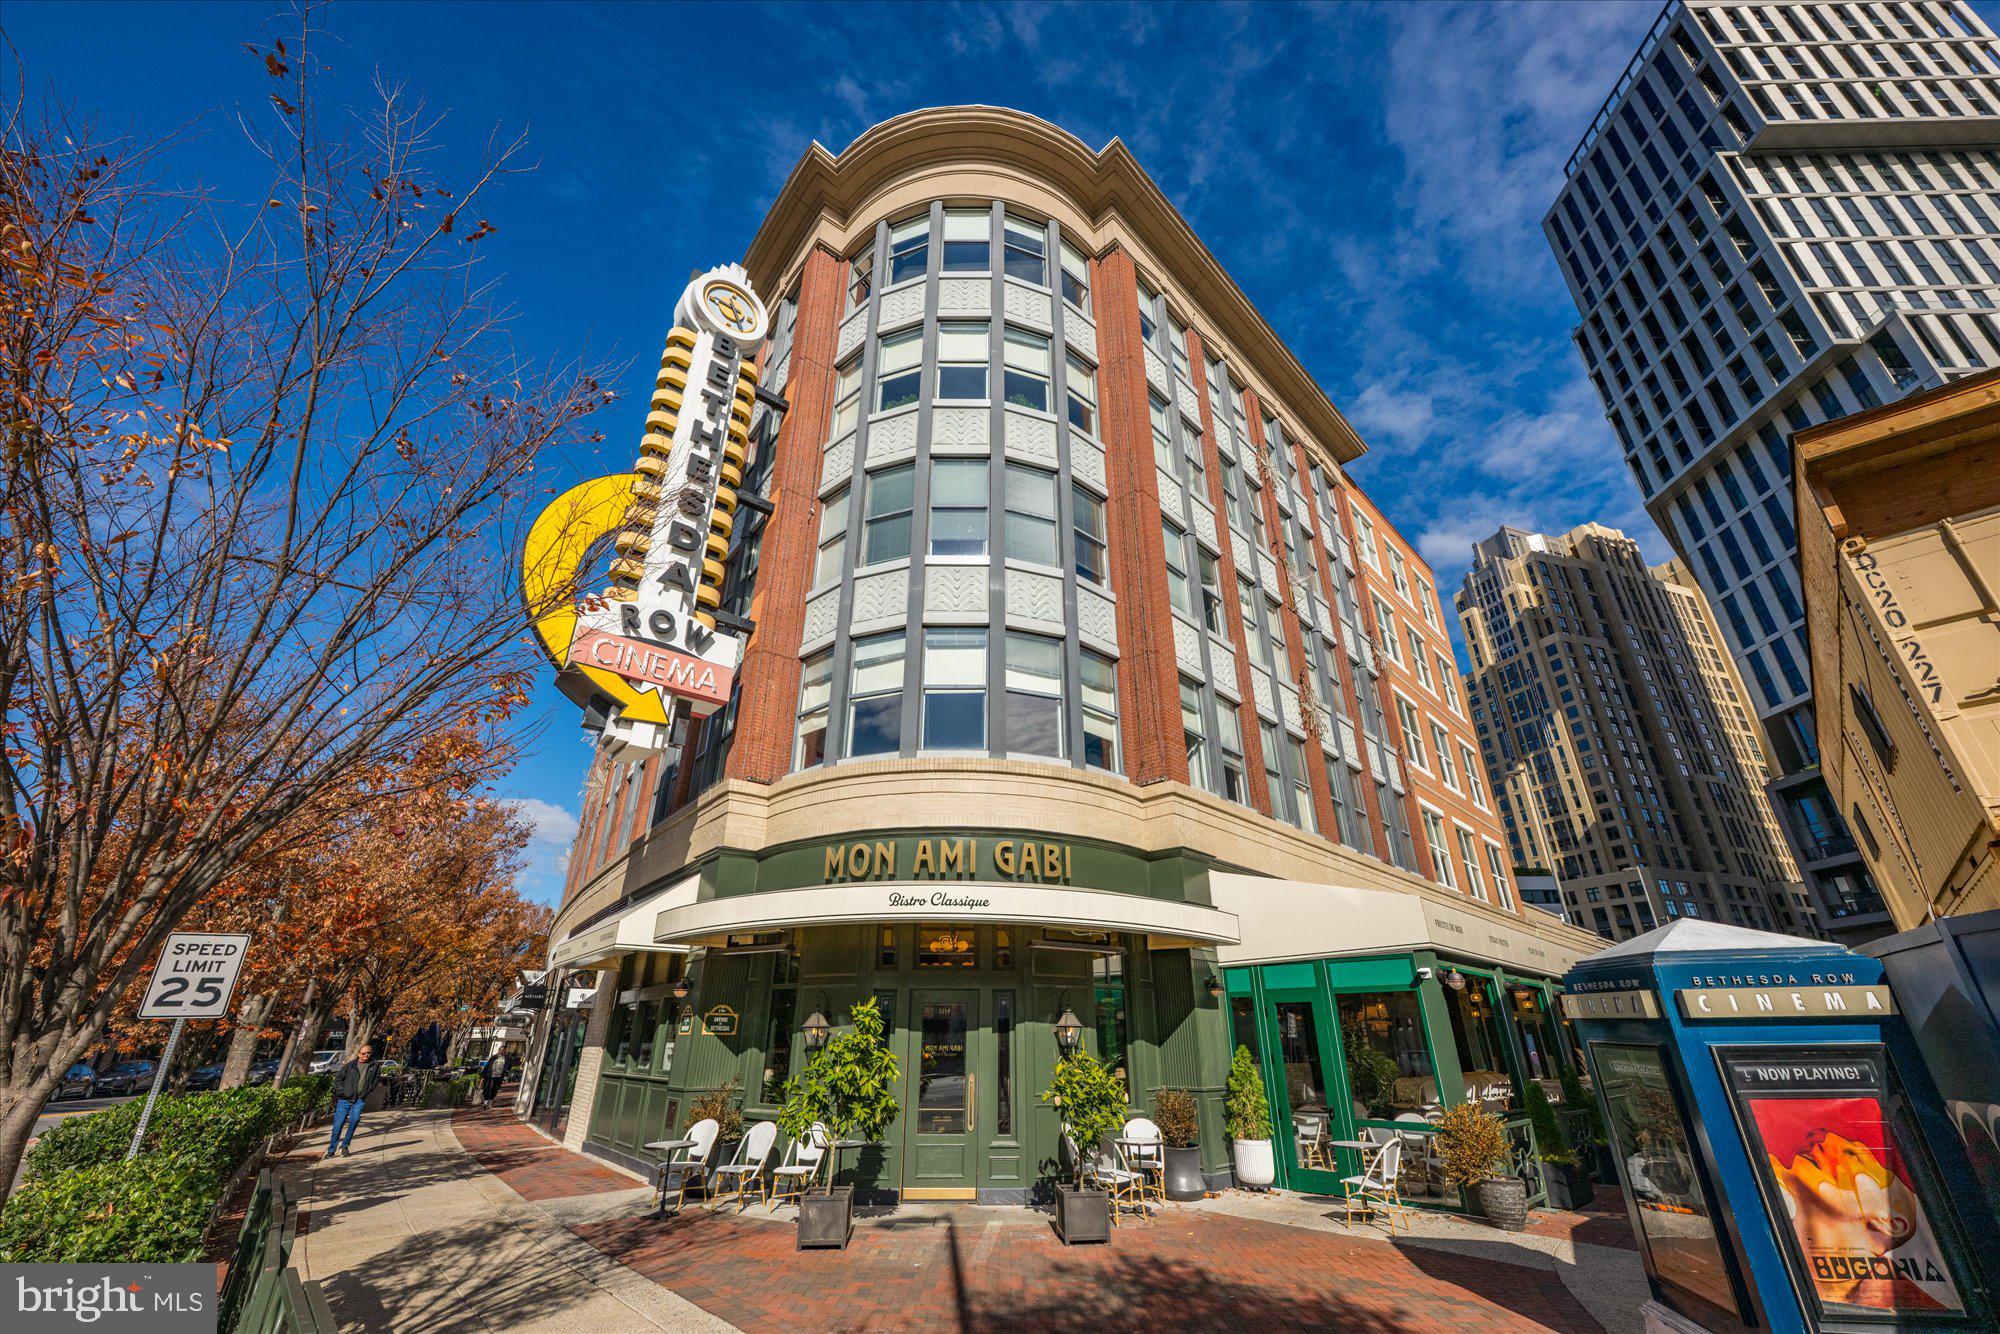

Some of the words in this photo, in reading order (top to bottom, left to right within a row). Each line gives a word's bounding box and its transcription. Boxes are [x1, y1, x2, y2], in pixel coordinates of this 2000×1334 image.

[656, 330, 736, 594] BETHESDA
[620, 604, 714, 653] ROW
[591, 638, 717, 694] CINEMA
[1901, 641, 1942, 703] 227
[824, 841, 896, 880] MON
[912, 840, 976, 878] AMI
[993, 840, 1071, 882] GABI
[888, 892, 927, 907] Bistro
[930, 892, 990, 910] Classique
[172, 943, 238, 956] SPEED
[172, 960, 226, 973] LIMIT
[152, 976, 225, 1007] 25
[1573, 981, 1616, 992] BETHESDA
[1619, 979, 1640, 988] ROW
[1693, 976, 1797, 987] BETHESDA
[1812, 973, 1855, 984] ROW
[1697, 991, 1883, 1012] CINEMA
[1757, 1067, 1791, 1081] NOW
[1793, 1066, 1860, 1080] PLAYING!
[1812, 1256, 1947, 1282] BUGONIA
